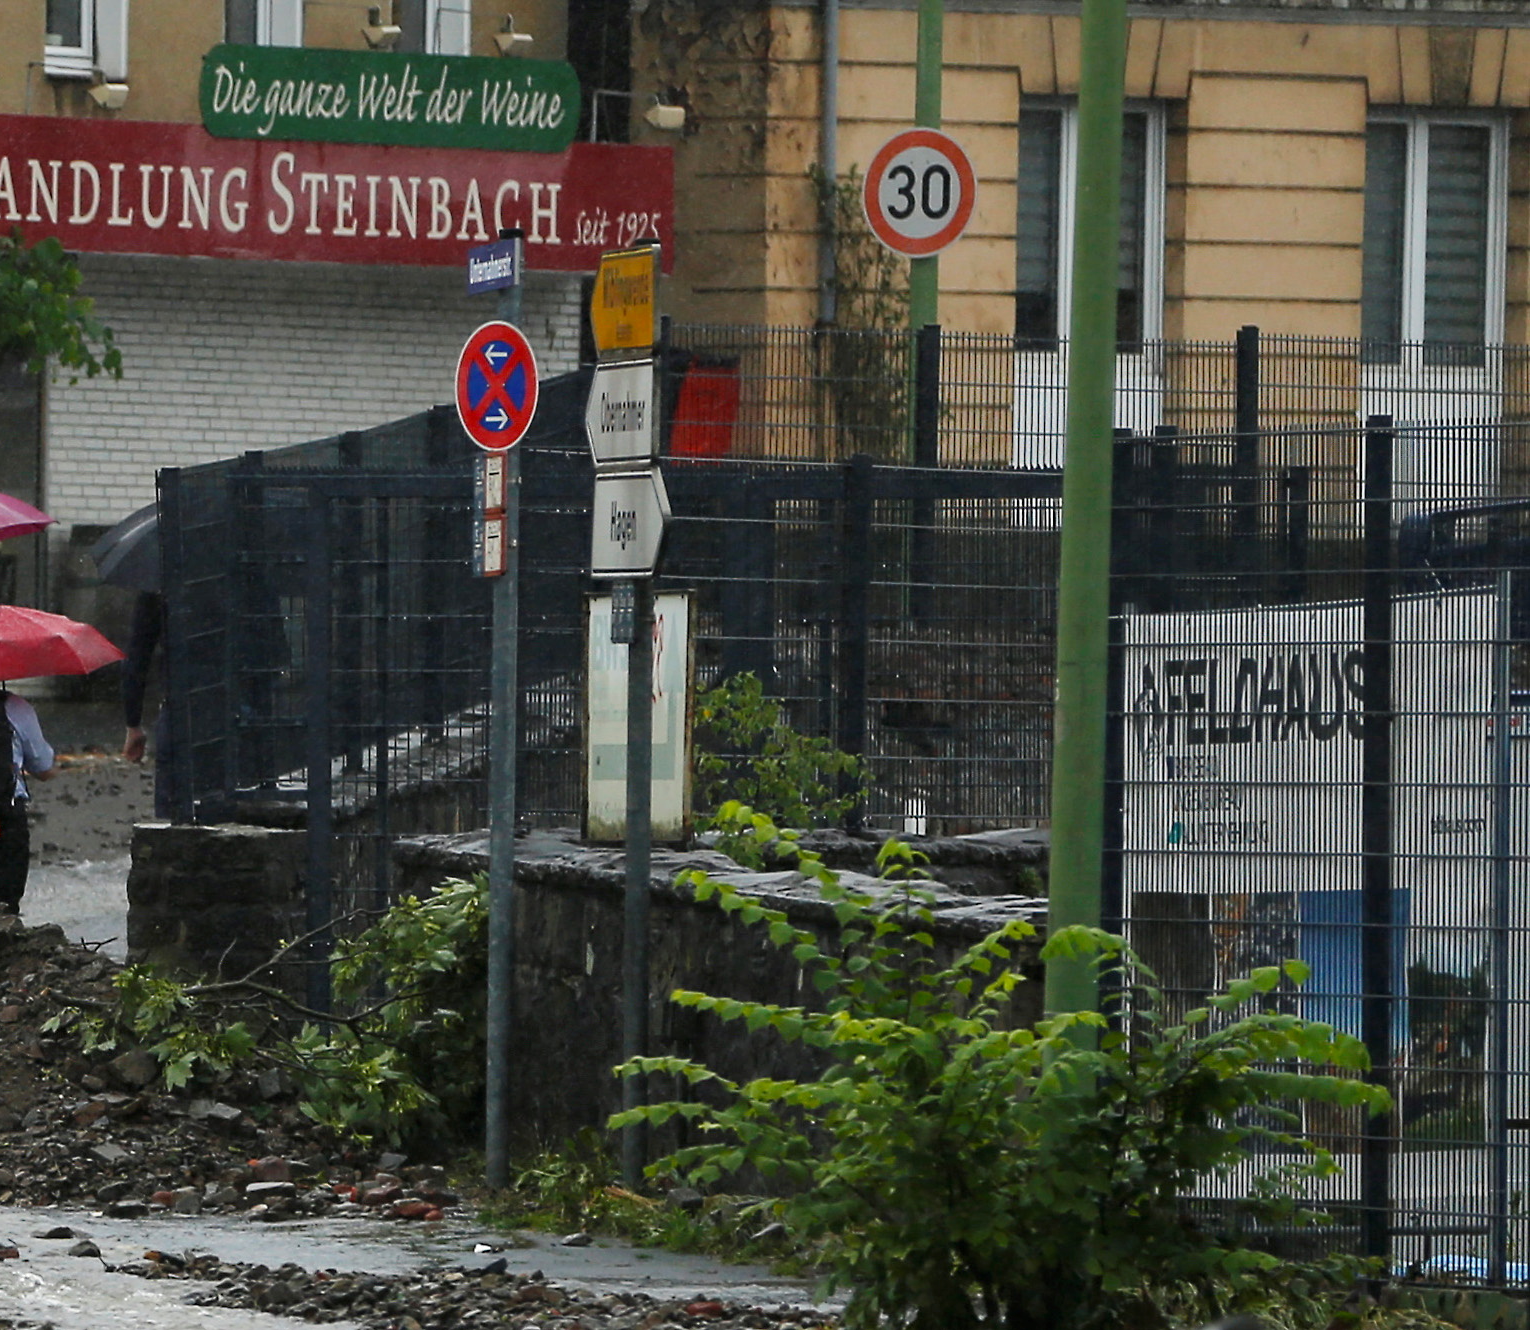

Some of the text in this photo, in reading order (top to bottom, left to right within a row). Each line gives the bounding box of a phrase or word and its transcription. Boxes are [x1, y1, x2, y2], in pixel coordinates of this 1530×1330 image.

[212, 61, 565, 135] Die ganze Welt der Weine
[267, 151, 562, 246] STEINBACH
[616, 211, 661, 247] 1925
[887, 164, 951, 219] 30
[611, 501, 637, 551] Hagen
